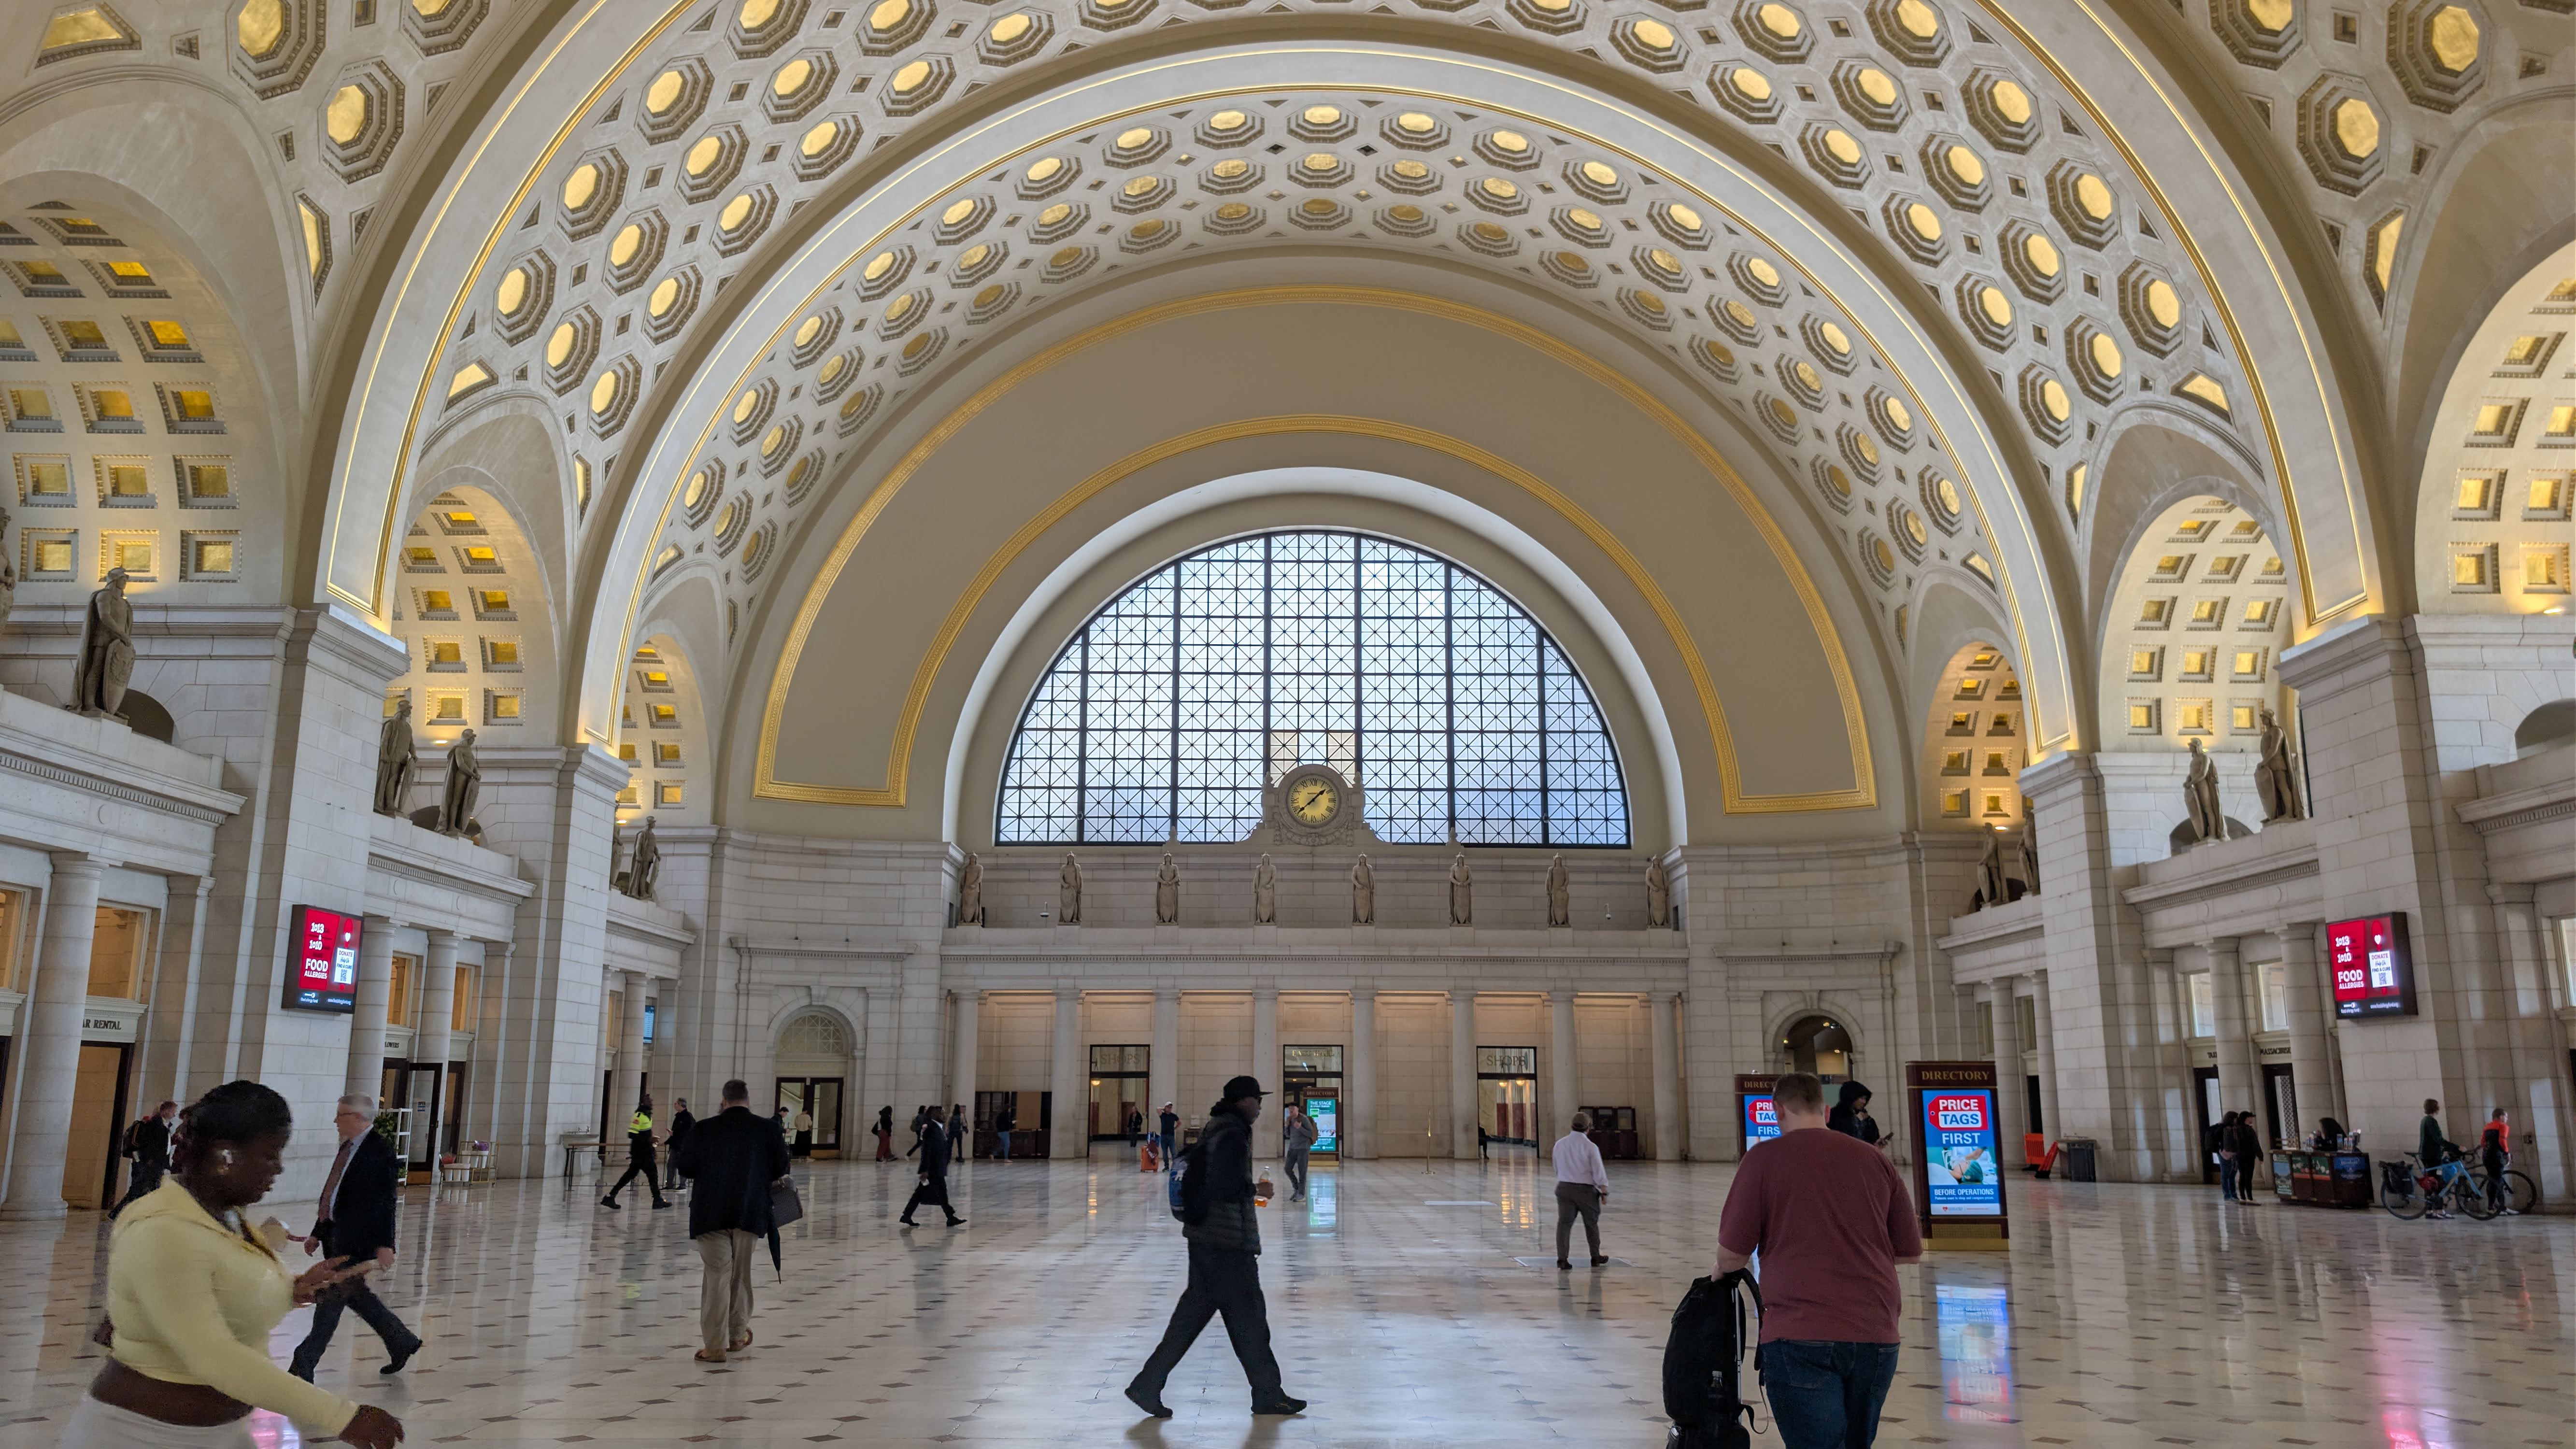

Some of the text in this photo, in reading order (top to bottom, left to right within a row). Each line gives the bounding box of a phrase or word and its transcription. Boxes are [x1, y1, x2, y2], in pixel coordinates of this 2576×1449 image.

[305, 958, 328, 972] FOOD
[304, 970, 327, 979] ALLERGIES
[2338, 969, 2363, 982] FOOD
[2339, 981, 2363, 990] ALLERGIES
[93, 1020, 121, 1030] RENTAL
[1101, 1054, 1140, 1065] SHOPS
[1487, 1055, 1525, 1066] SHOPS
[1921, 1070, 1989, 1080] DIRECTORY
[1939, 1099, 1978, 1110] PRICE
[1941, 1114, 1979, 1124] TAGS
[1758, 1126, 1780, 1135] FIRS
[1942, 1133, 1980, 1144] FIRST
